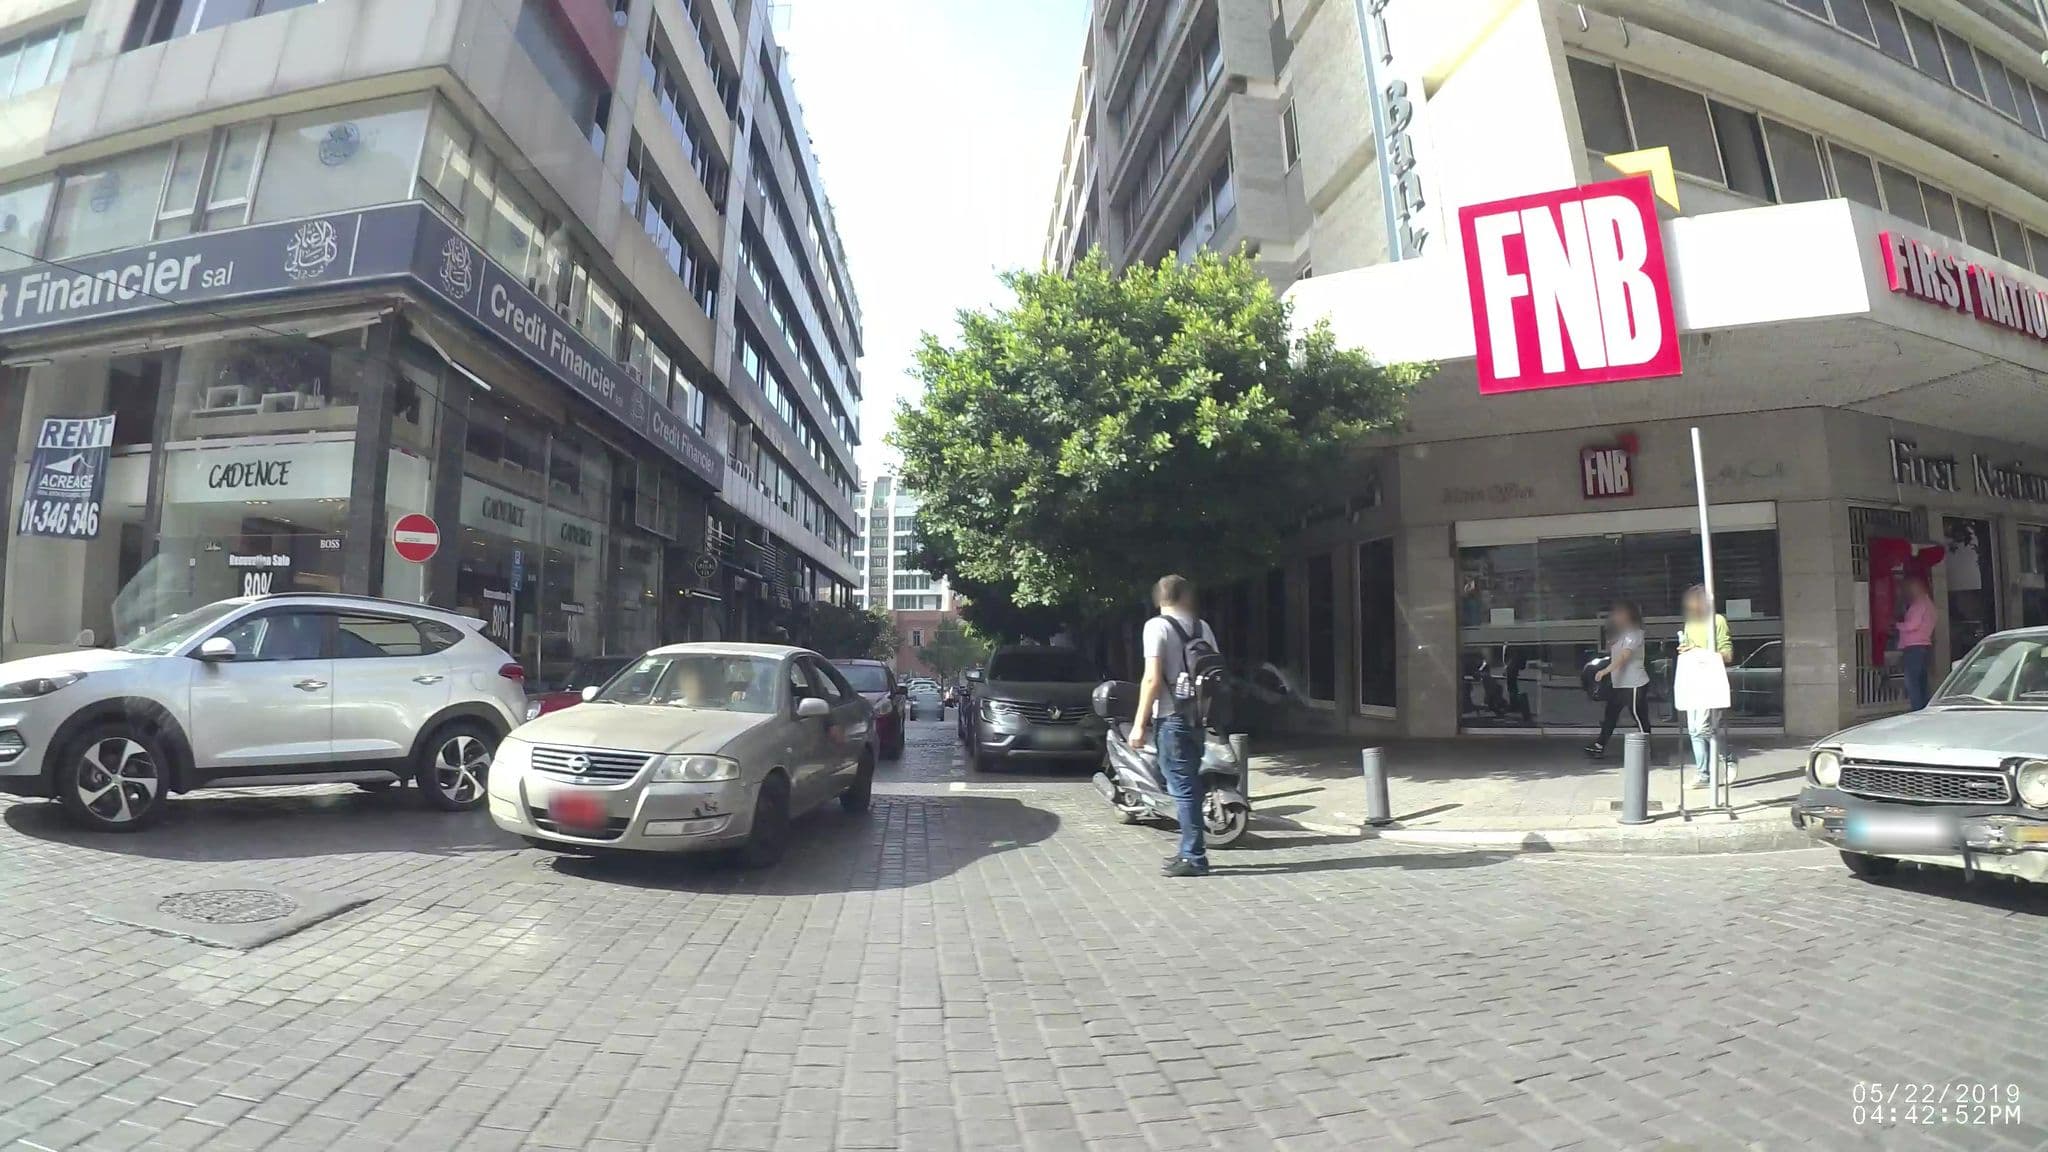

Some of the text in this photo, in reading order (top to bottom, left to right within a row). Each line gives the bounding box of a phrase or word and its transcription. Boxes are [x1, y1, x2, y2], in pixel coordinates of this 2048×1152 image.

[15, 251, 202, 317] Financier
[202, 261, 234, 288] sal
[1474, 195, 1662, 380] FNB
[1879, 231, 2048, 339] FIRST NATIO
[491, 284, 616, 399] Credit Financier
[43, 420, 112, 447] RENT
[653, 411, 715, 474] Credit Financier
[40, 474, 94, 488] ACREAGE
[209, 459, 292, 488] CADENCE
[1584, 450, 1630, 496] FNB
[70, 501, 99, 536] 546
[320, 539, 340, 549] BOSS
